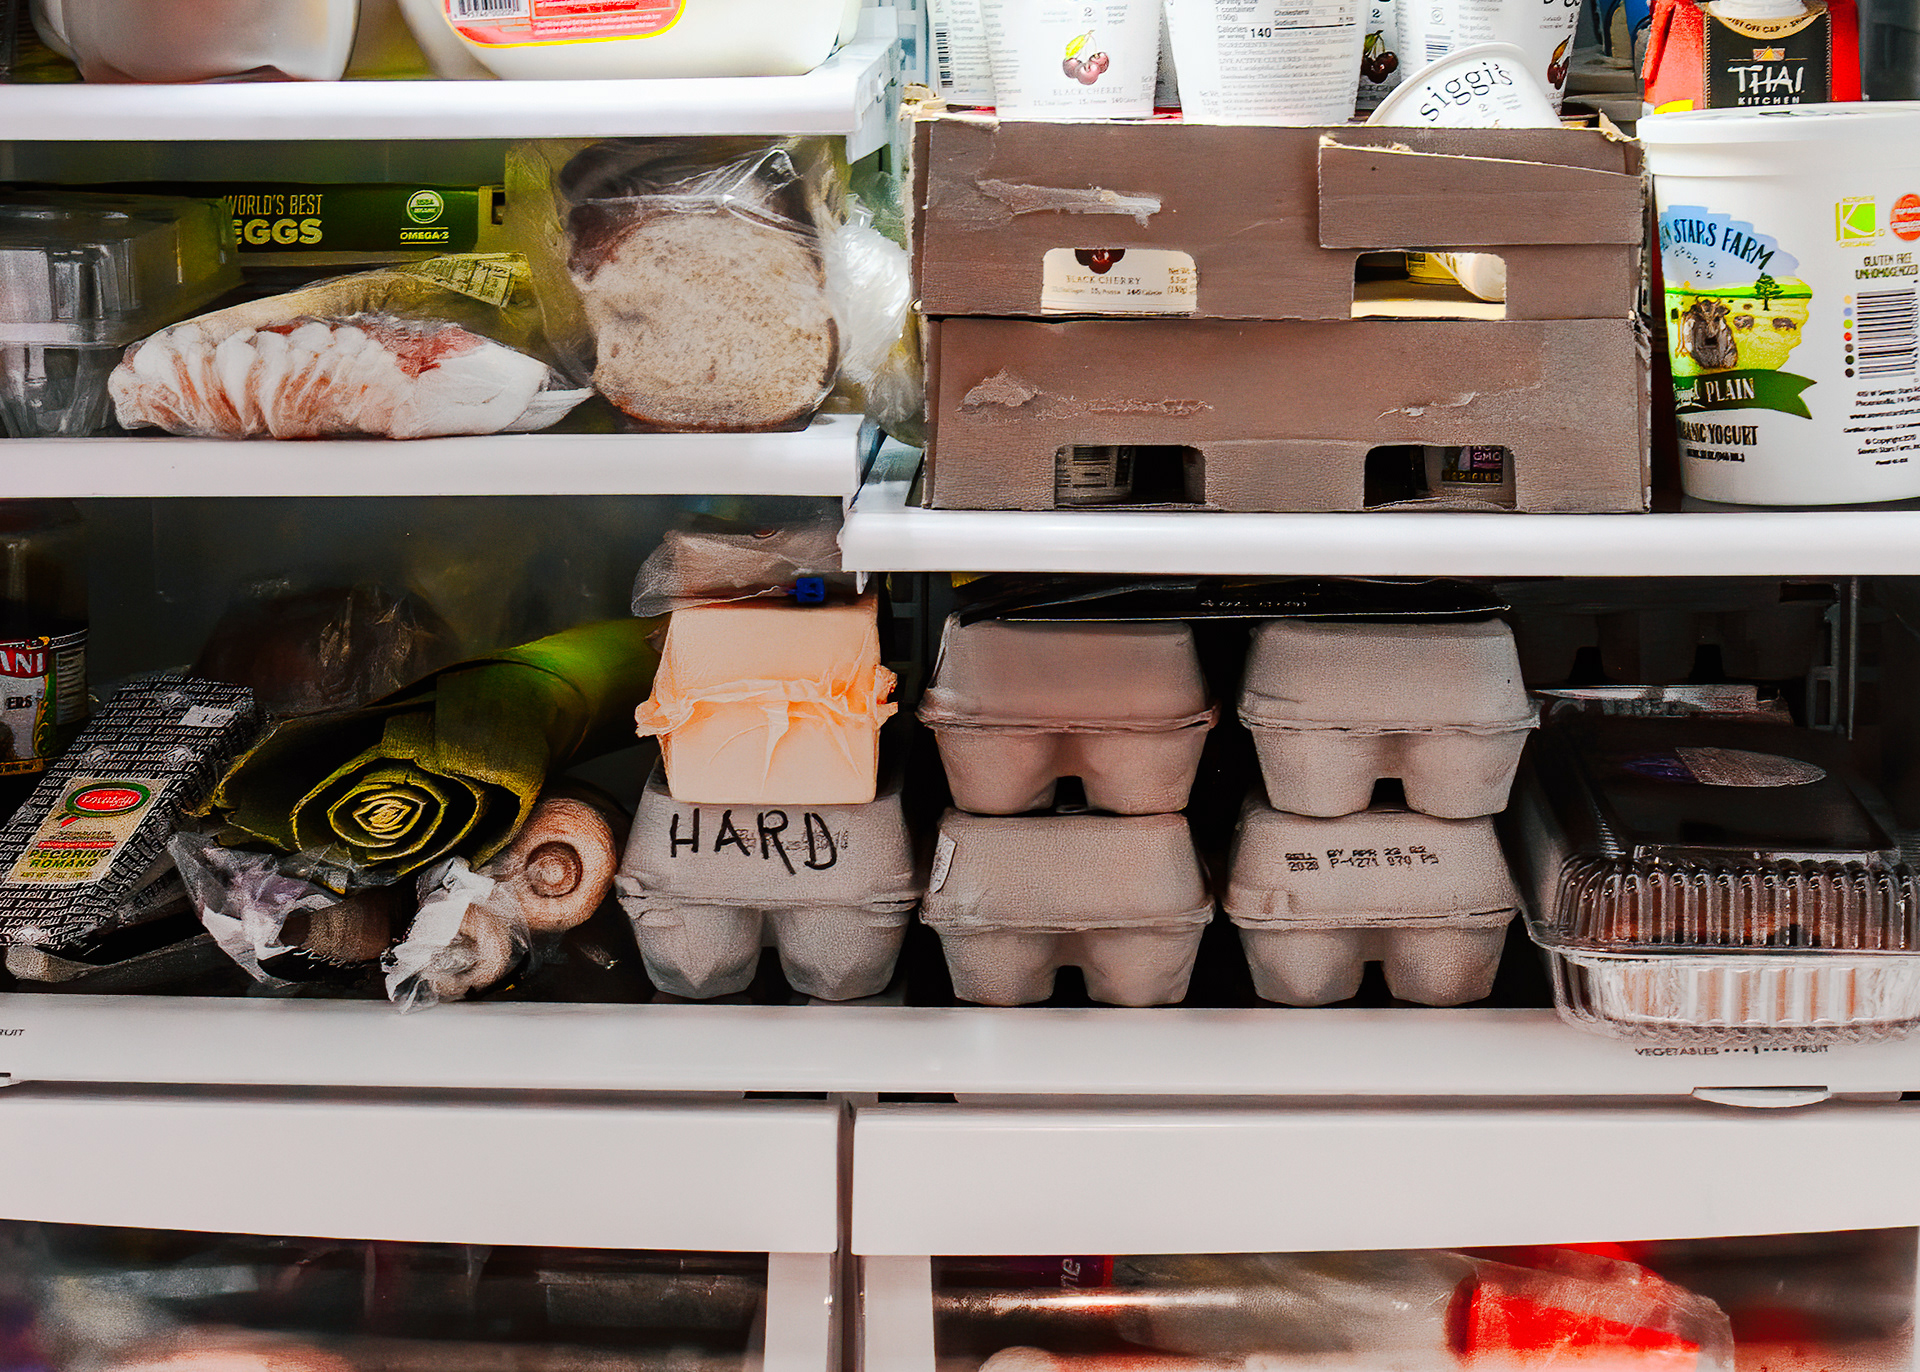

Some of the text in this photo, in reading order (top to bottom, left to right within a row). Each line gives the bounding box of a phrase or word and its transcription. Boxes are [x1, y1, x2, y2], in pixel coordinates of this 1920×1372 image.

[1371, 8, 1381, 18] 2
[1251, 27, 1272, 39] 140
[1727, 64, 1804, 95] THAI
[1419, 61, 1513, 122] siggi's
[1737, 96, 1801, 106] KITCHEN
[224, 194, 325, 216] WORLD'S BEST
[1673, 218, 1717, 247] STARS
[1721, 227, 1775, 270] FARM
[1098, 276, 1142, 285] CHERRY
[1704, 377, 1755, 403] PLAIN
[1707, 423, 1759, 446] YOGURT
[669, 807, 838, 876] HARD
[29, 849, 112, 859] PECORINO
[29, 858, 99, 869] ROMANO
[1634, 1045, 1829, 1056] VEGETABLES FRUIT
